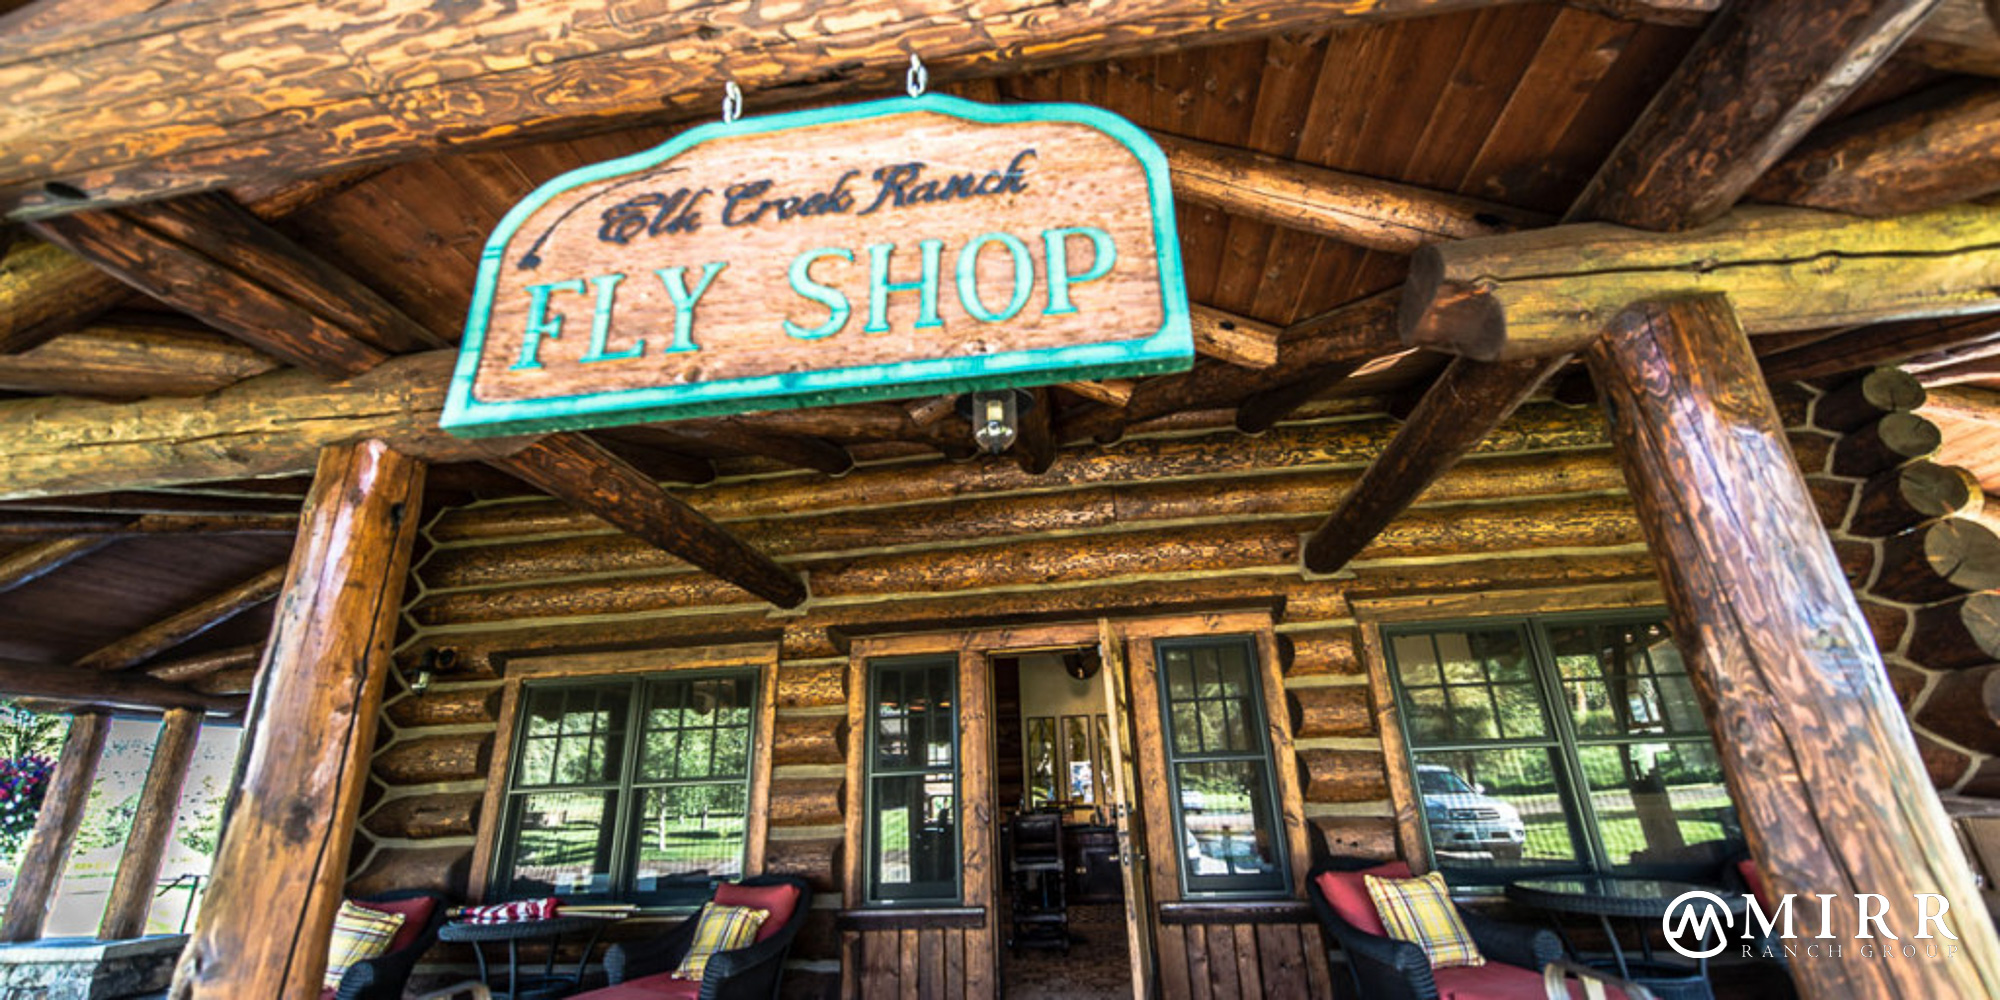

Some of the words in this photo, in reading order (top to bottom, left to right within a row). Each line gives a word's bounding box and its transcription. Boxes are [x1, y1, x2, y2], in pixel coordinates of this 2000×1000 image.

[599, 188, 712, 245] Elk
[721, 169, 857, 227] Creek
[857, 148, 1038, 216] Ranch
[509, 260, 728, 372] FLY
[781, 225, 1119, 341] SHOP
